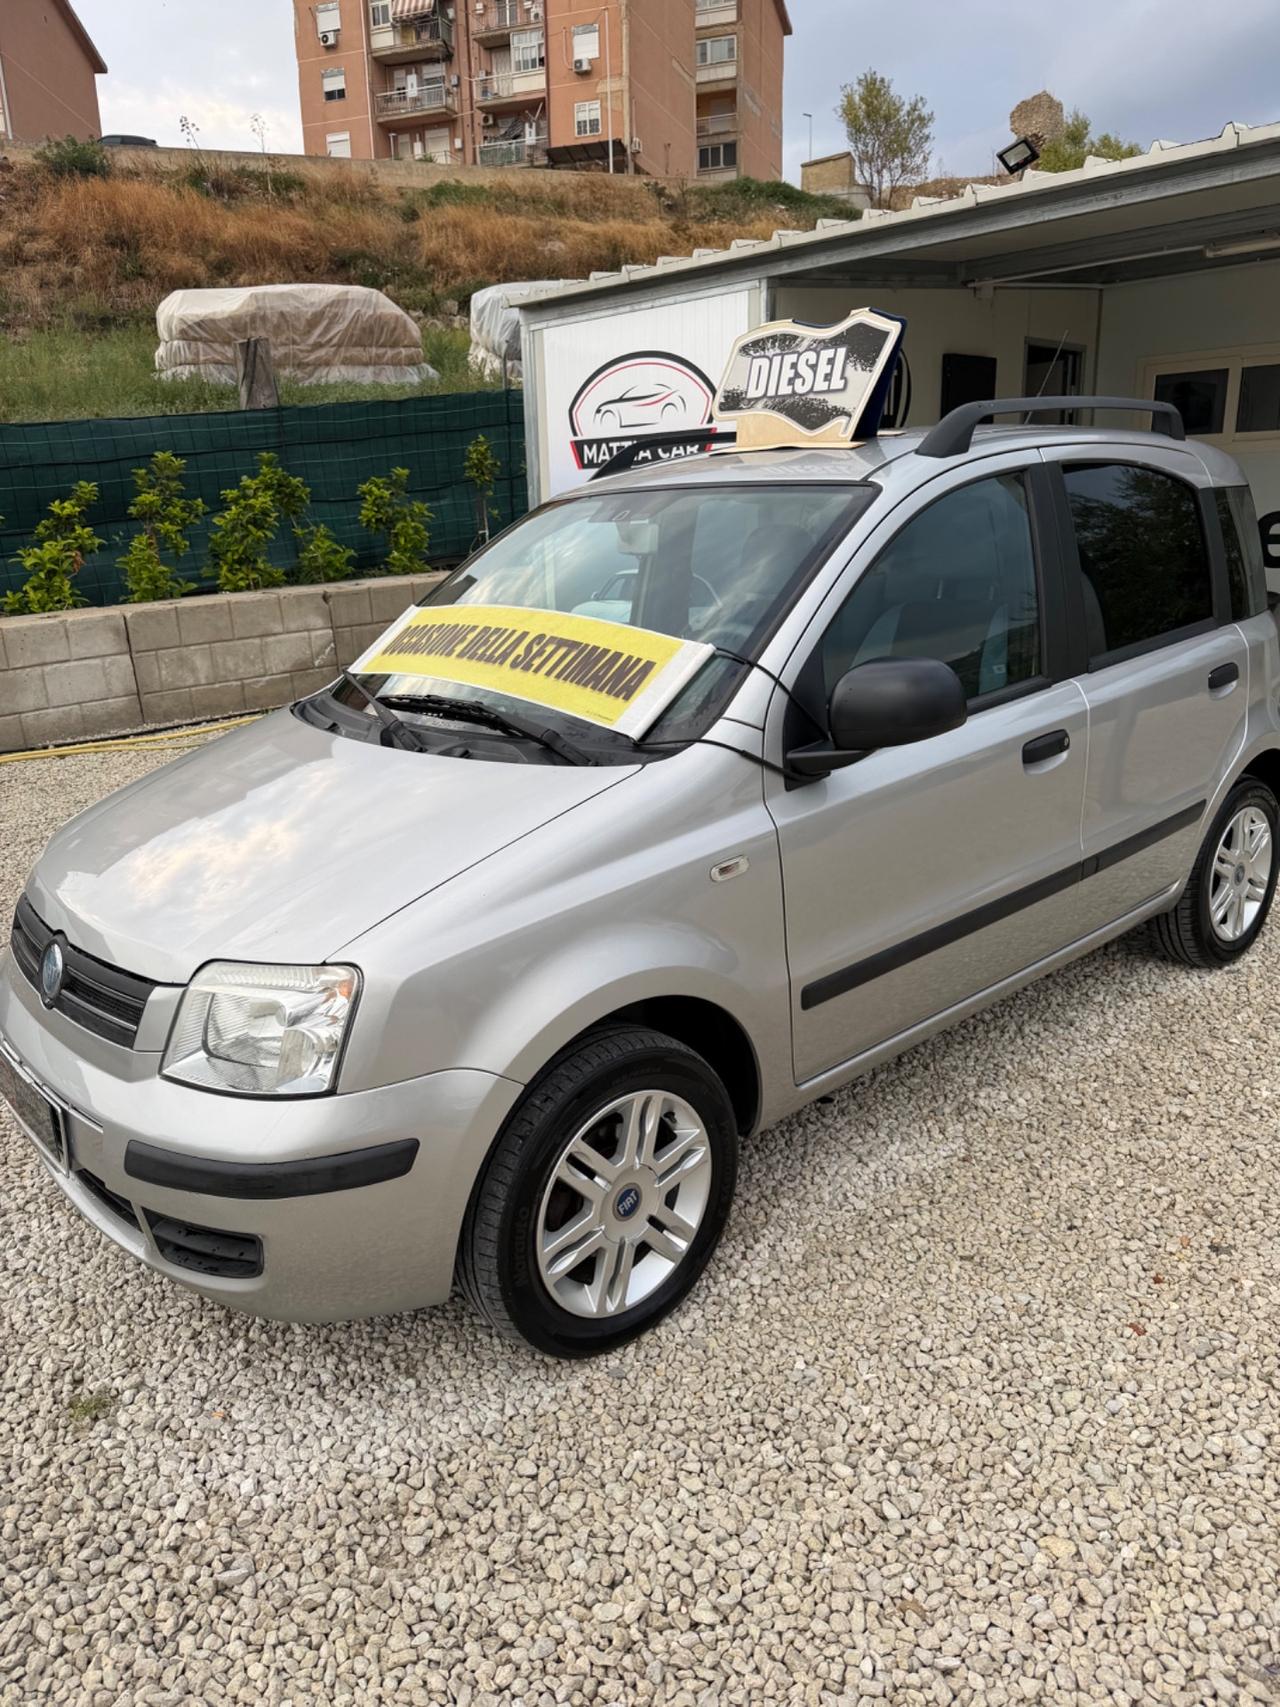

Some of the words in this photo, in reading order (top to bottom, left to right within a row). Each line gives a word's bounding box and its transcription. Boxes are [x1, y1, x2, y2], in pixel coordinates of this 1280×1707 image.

[746, 347, 847, 399] DIESEL
[381, 623, 479, 657] OCCASIONE
[456, 626, 531, 666] DELLA
[510, 633, 657, 701] SETTIMANA
[618, 1190, 638, 1215] FIAT
